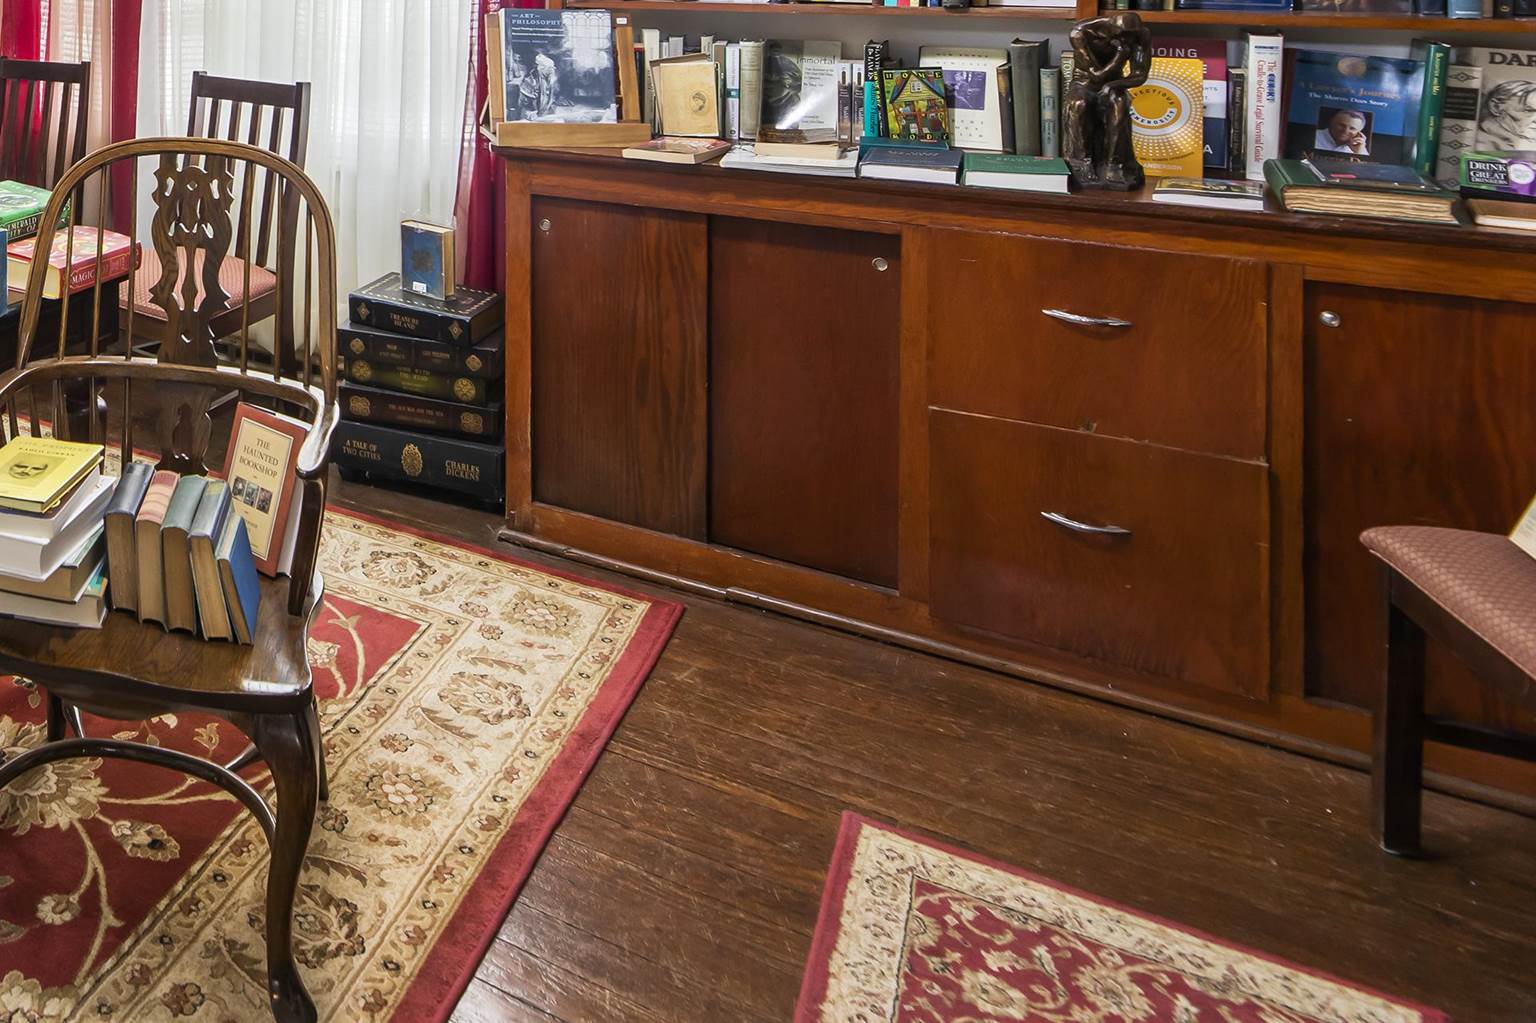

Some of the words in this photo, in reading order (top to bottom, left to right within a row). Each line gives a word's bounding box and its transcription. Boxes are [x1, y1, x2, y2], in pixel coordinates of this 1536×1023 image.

[511, 18, 562, 26] PHILOSOPHY
[796, 55, 836, 65] Immortal
[1267, 60, 1276, 72] The
[884, 71, 943, 80] HOME
[1255, 59, 1266, 104] Cradle-to-Grave
[1308, 92, 1323, 100] The
[1368, 99, 1389, 109] Story
[1254, 104, 1264, 120] Legal
[1254, 120, 1264, 145] Survival
[1253, 145, 1264, 163] Guide
[1469, 160, 1507, 173] DRINK
[1469, 170, 1507, 181] GREAT
[7, 216, 38, 232] EMERALD
[72, 269, 95, 285] MAGIC
[389, 312, 420, 326] TREASURE
[394, 320, 416, 330] ISLAND
[256, 437, 272, 451] THE
[352, 439, 368, 449] TALE
[368, 443, 378, 451] OF
[243, 444, 279, 468] HAUNTED
[342, 446, 357, 456] TWO
[359, 449, 381, 461] CITIES
[238, 455, 279, 479] BOOKSHOP
[445, 459, 481, 473] CHARLES
[446, 466, 480, 482] DICKENS
